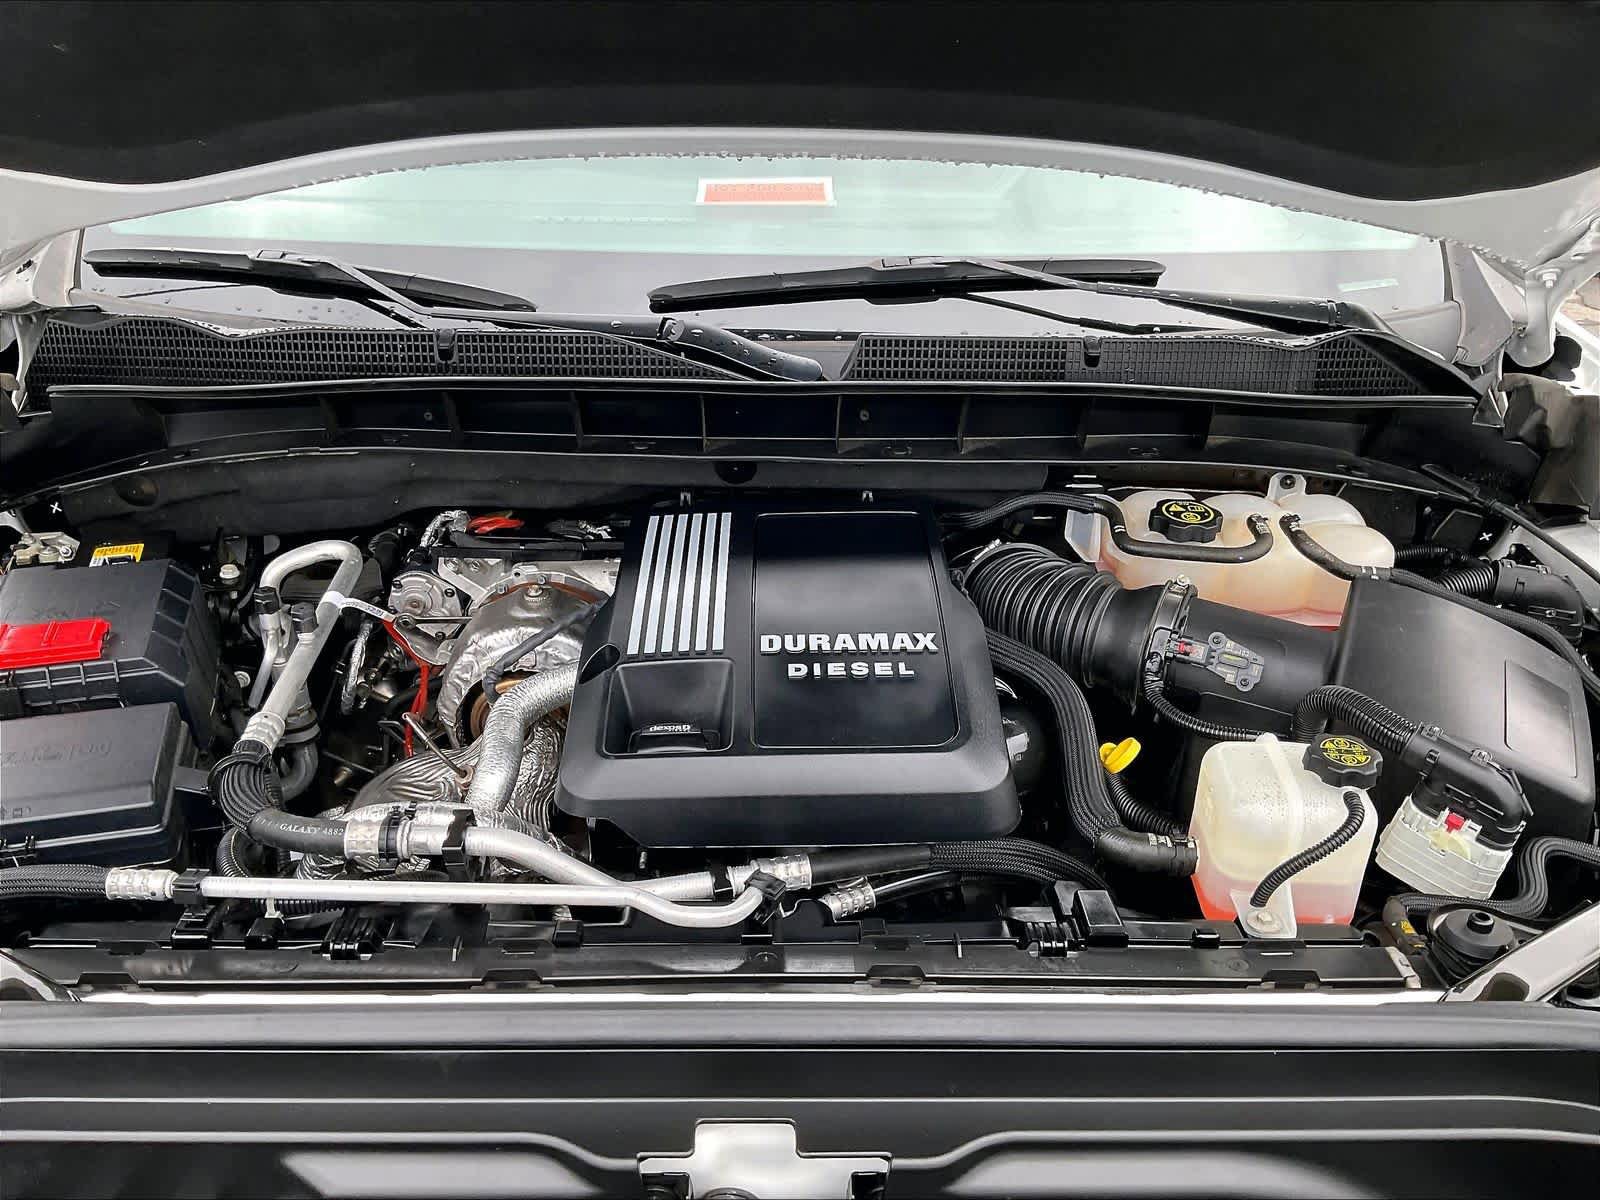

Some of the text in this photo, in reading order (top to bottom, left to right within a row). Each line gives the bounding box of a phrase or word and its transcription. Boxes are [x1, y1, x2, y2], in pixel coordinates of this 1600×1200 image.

[759, 632, 938, 654] DURAMAX
[787, 661, 916, 680] DIESEL
[279, 823, 321, 834] GALAXY
